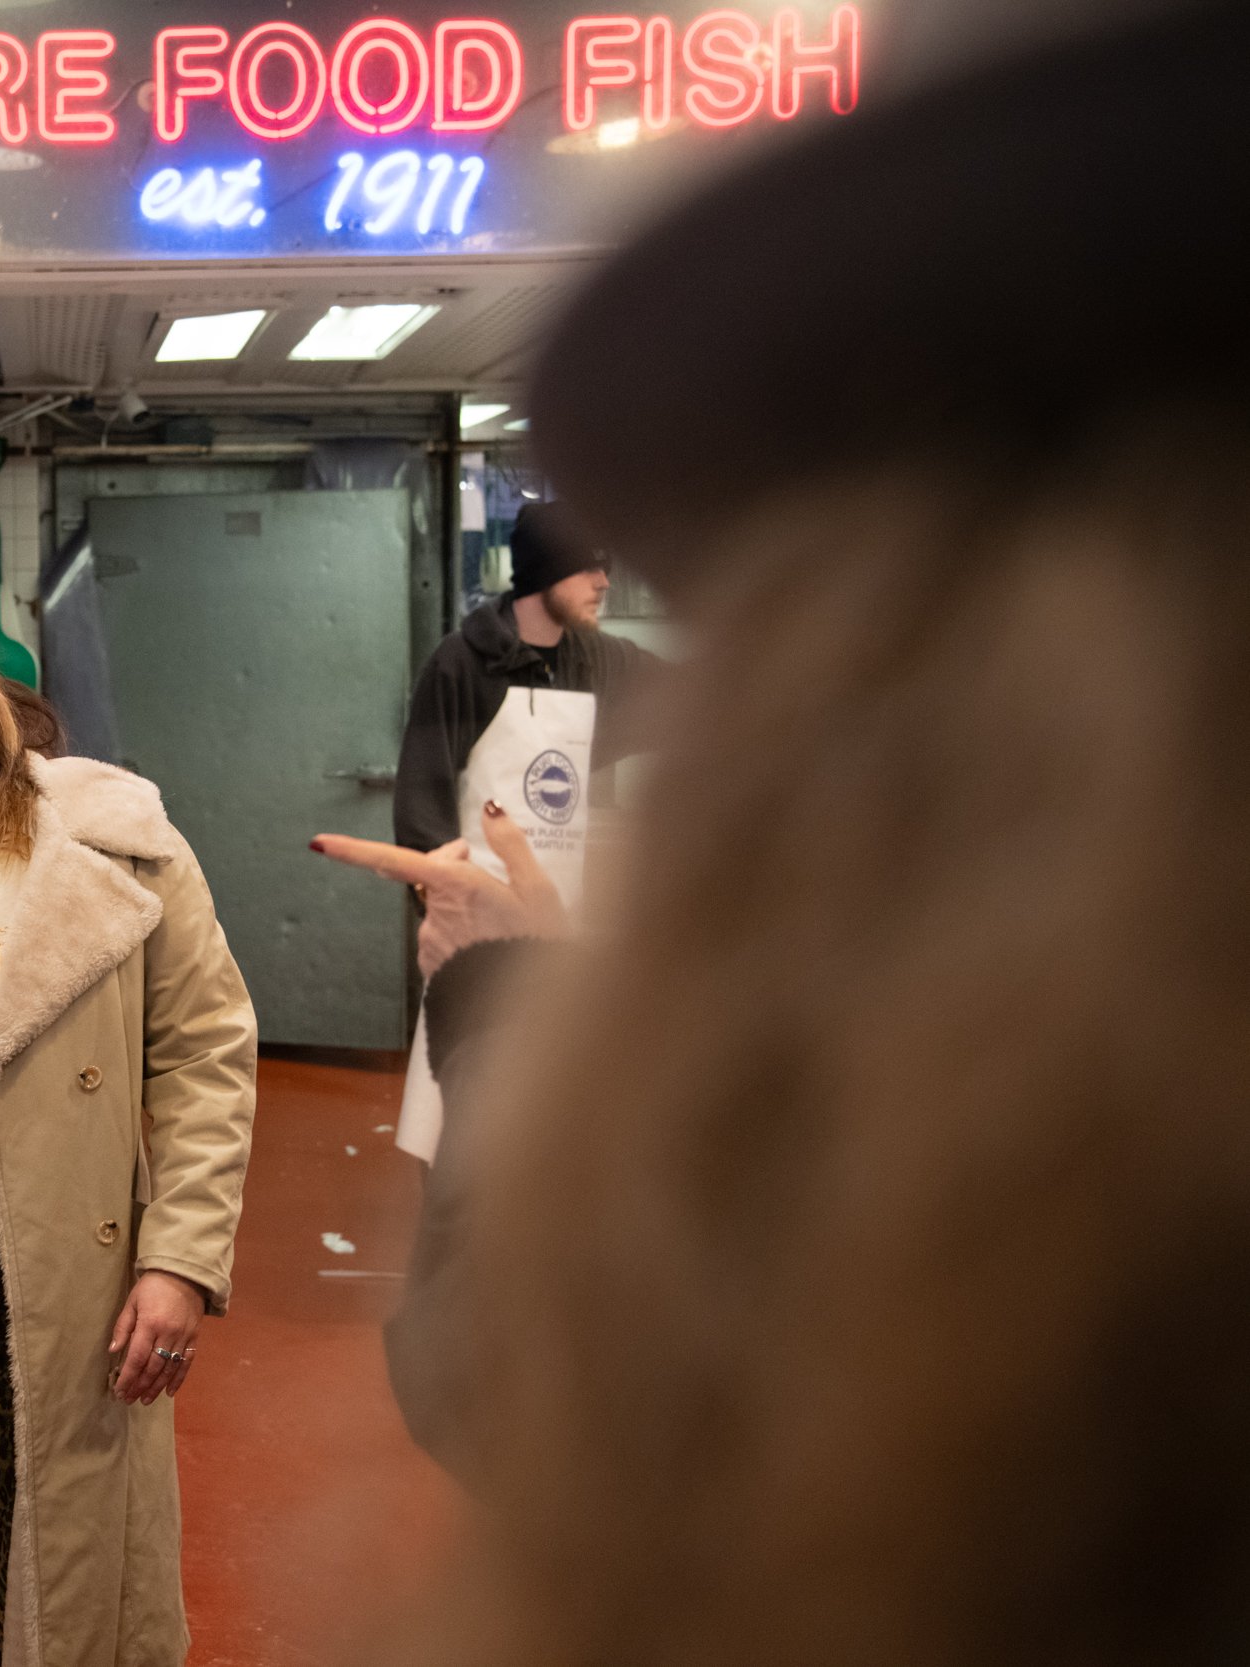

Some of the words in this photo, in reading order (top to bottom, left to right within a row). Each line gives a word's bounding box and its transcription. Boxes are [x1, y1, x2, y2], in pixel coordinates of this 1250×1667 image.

[153, 18, 524, 141] FOOD
[563, 4, 861, 131] FISH
[139, 157, 267, 228] est.
[324, 150, 486, 235] 1911
